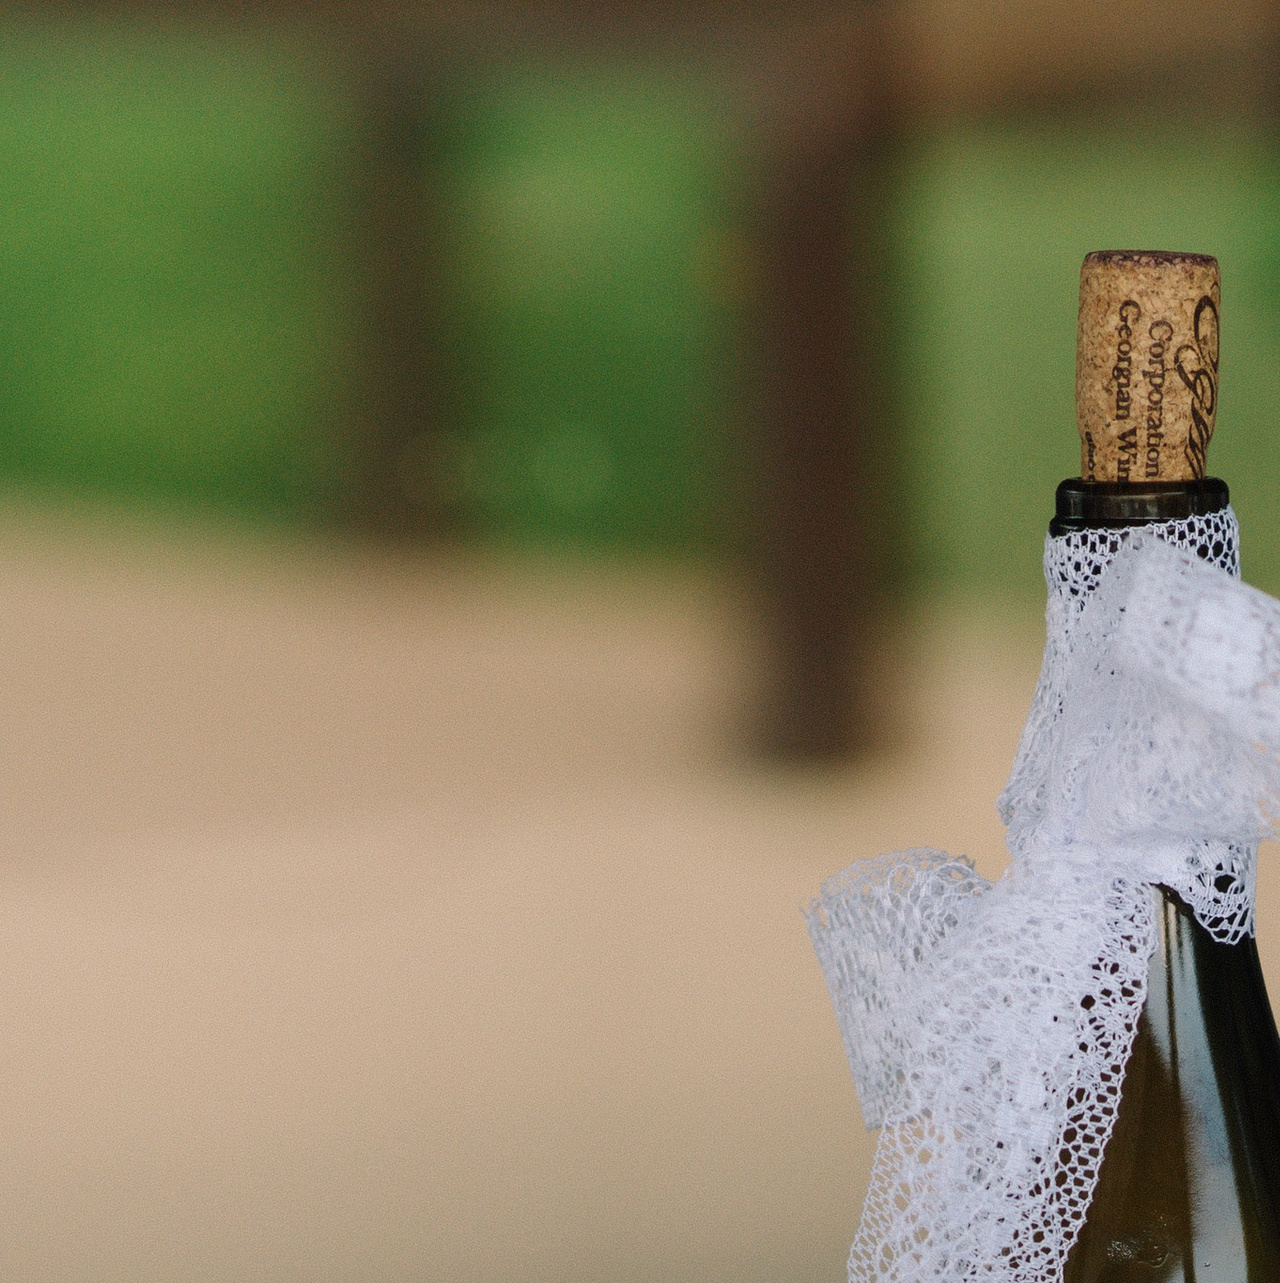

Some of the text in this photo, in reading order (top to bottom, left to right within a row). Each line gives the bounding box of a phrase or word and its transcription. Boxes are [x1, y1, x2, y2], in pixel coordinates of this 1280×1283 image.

[1112, 299, 1141, 482] Georgian Win
[1143, 319, 1174, 478] Corporation
